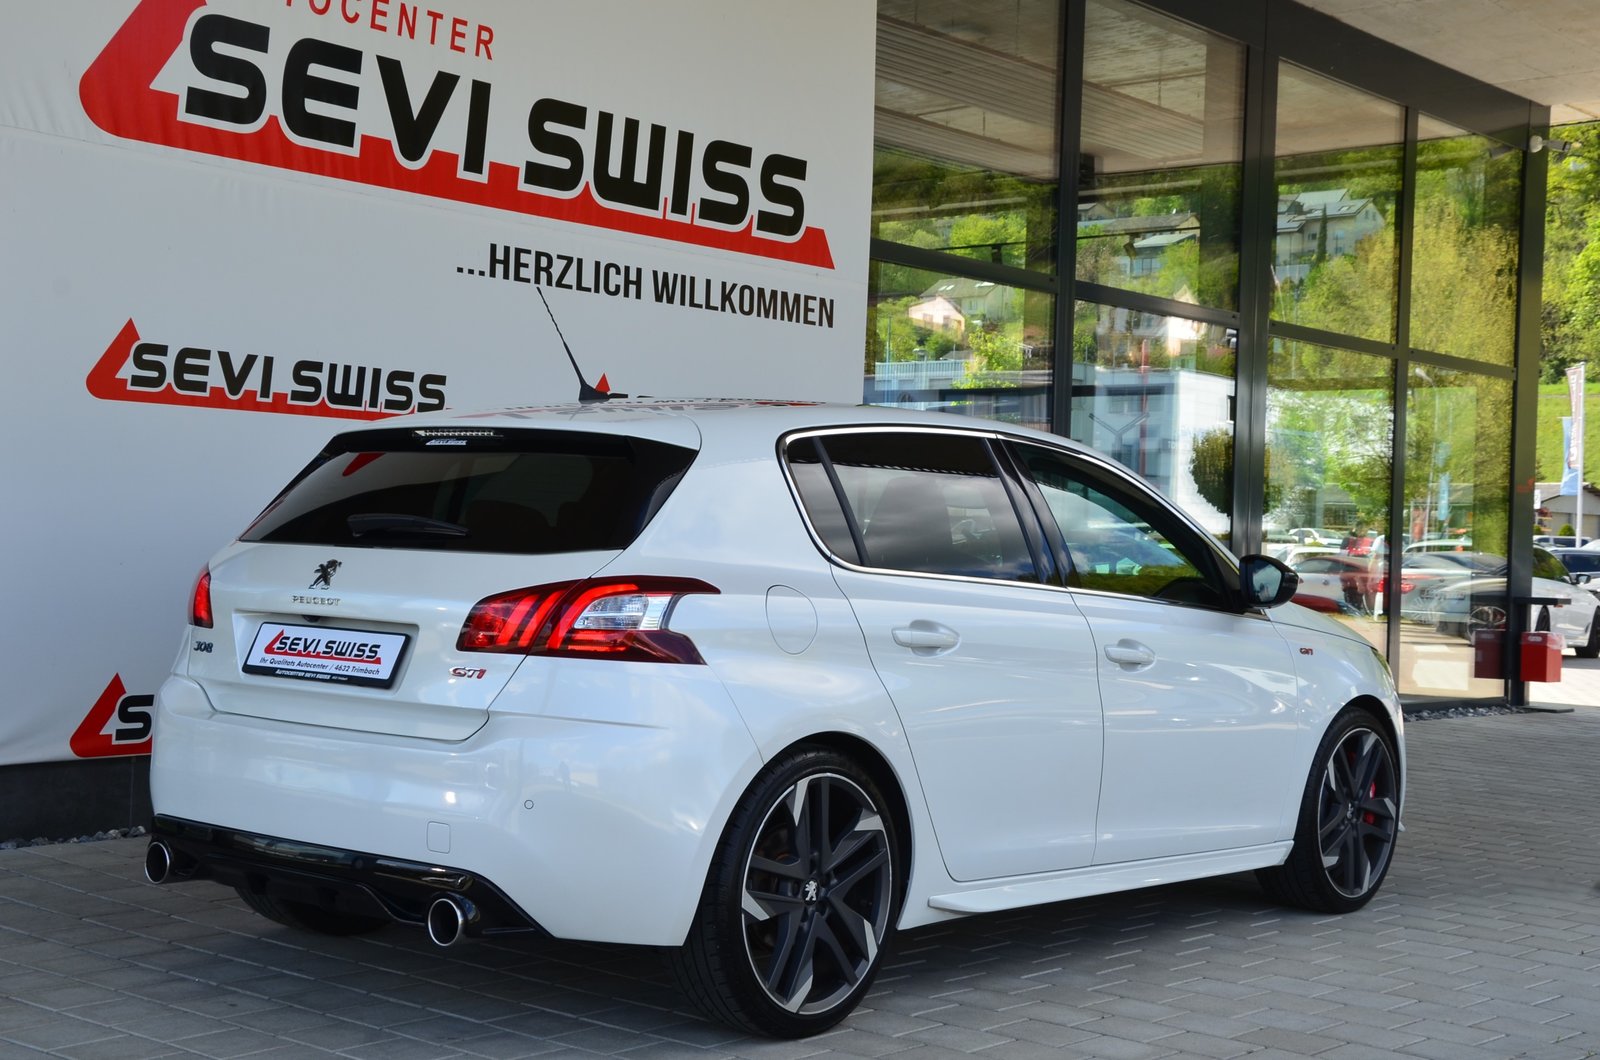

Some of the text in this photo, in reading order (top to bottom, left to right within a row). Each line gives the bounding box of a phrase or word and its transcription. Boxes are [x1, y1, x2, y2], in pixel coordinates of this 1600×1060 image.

[286, 0, 495, 61] CENTER
[185, 14, 808, 236] SEVI SWISS
[652, 269, 835, 329] WILLKOMMEN
[130, 342, 447, 413] SEVI SWISS
[292, 595, 341, 606] PEUGEOT
[193, 641, 214, 653] 308
[259, 657, 269, 665] Ihr
[296, 661, 329, 670] Autocenter
[334, 664, 351, 673] 4632
[351, 665, 380, 676] Trimbach
[276, 636, 381, 660] SEVI SWISS
